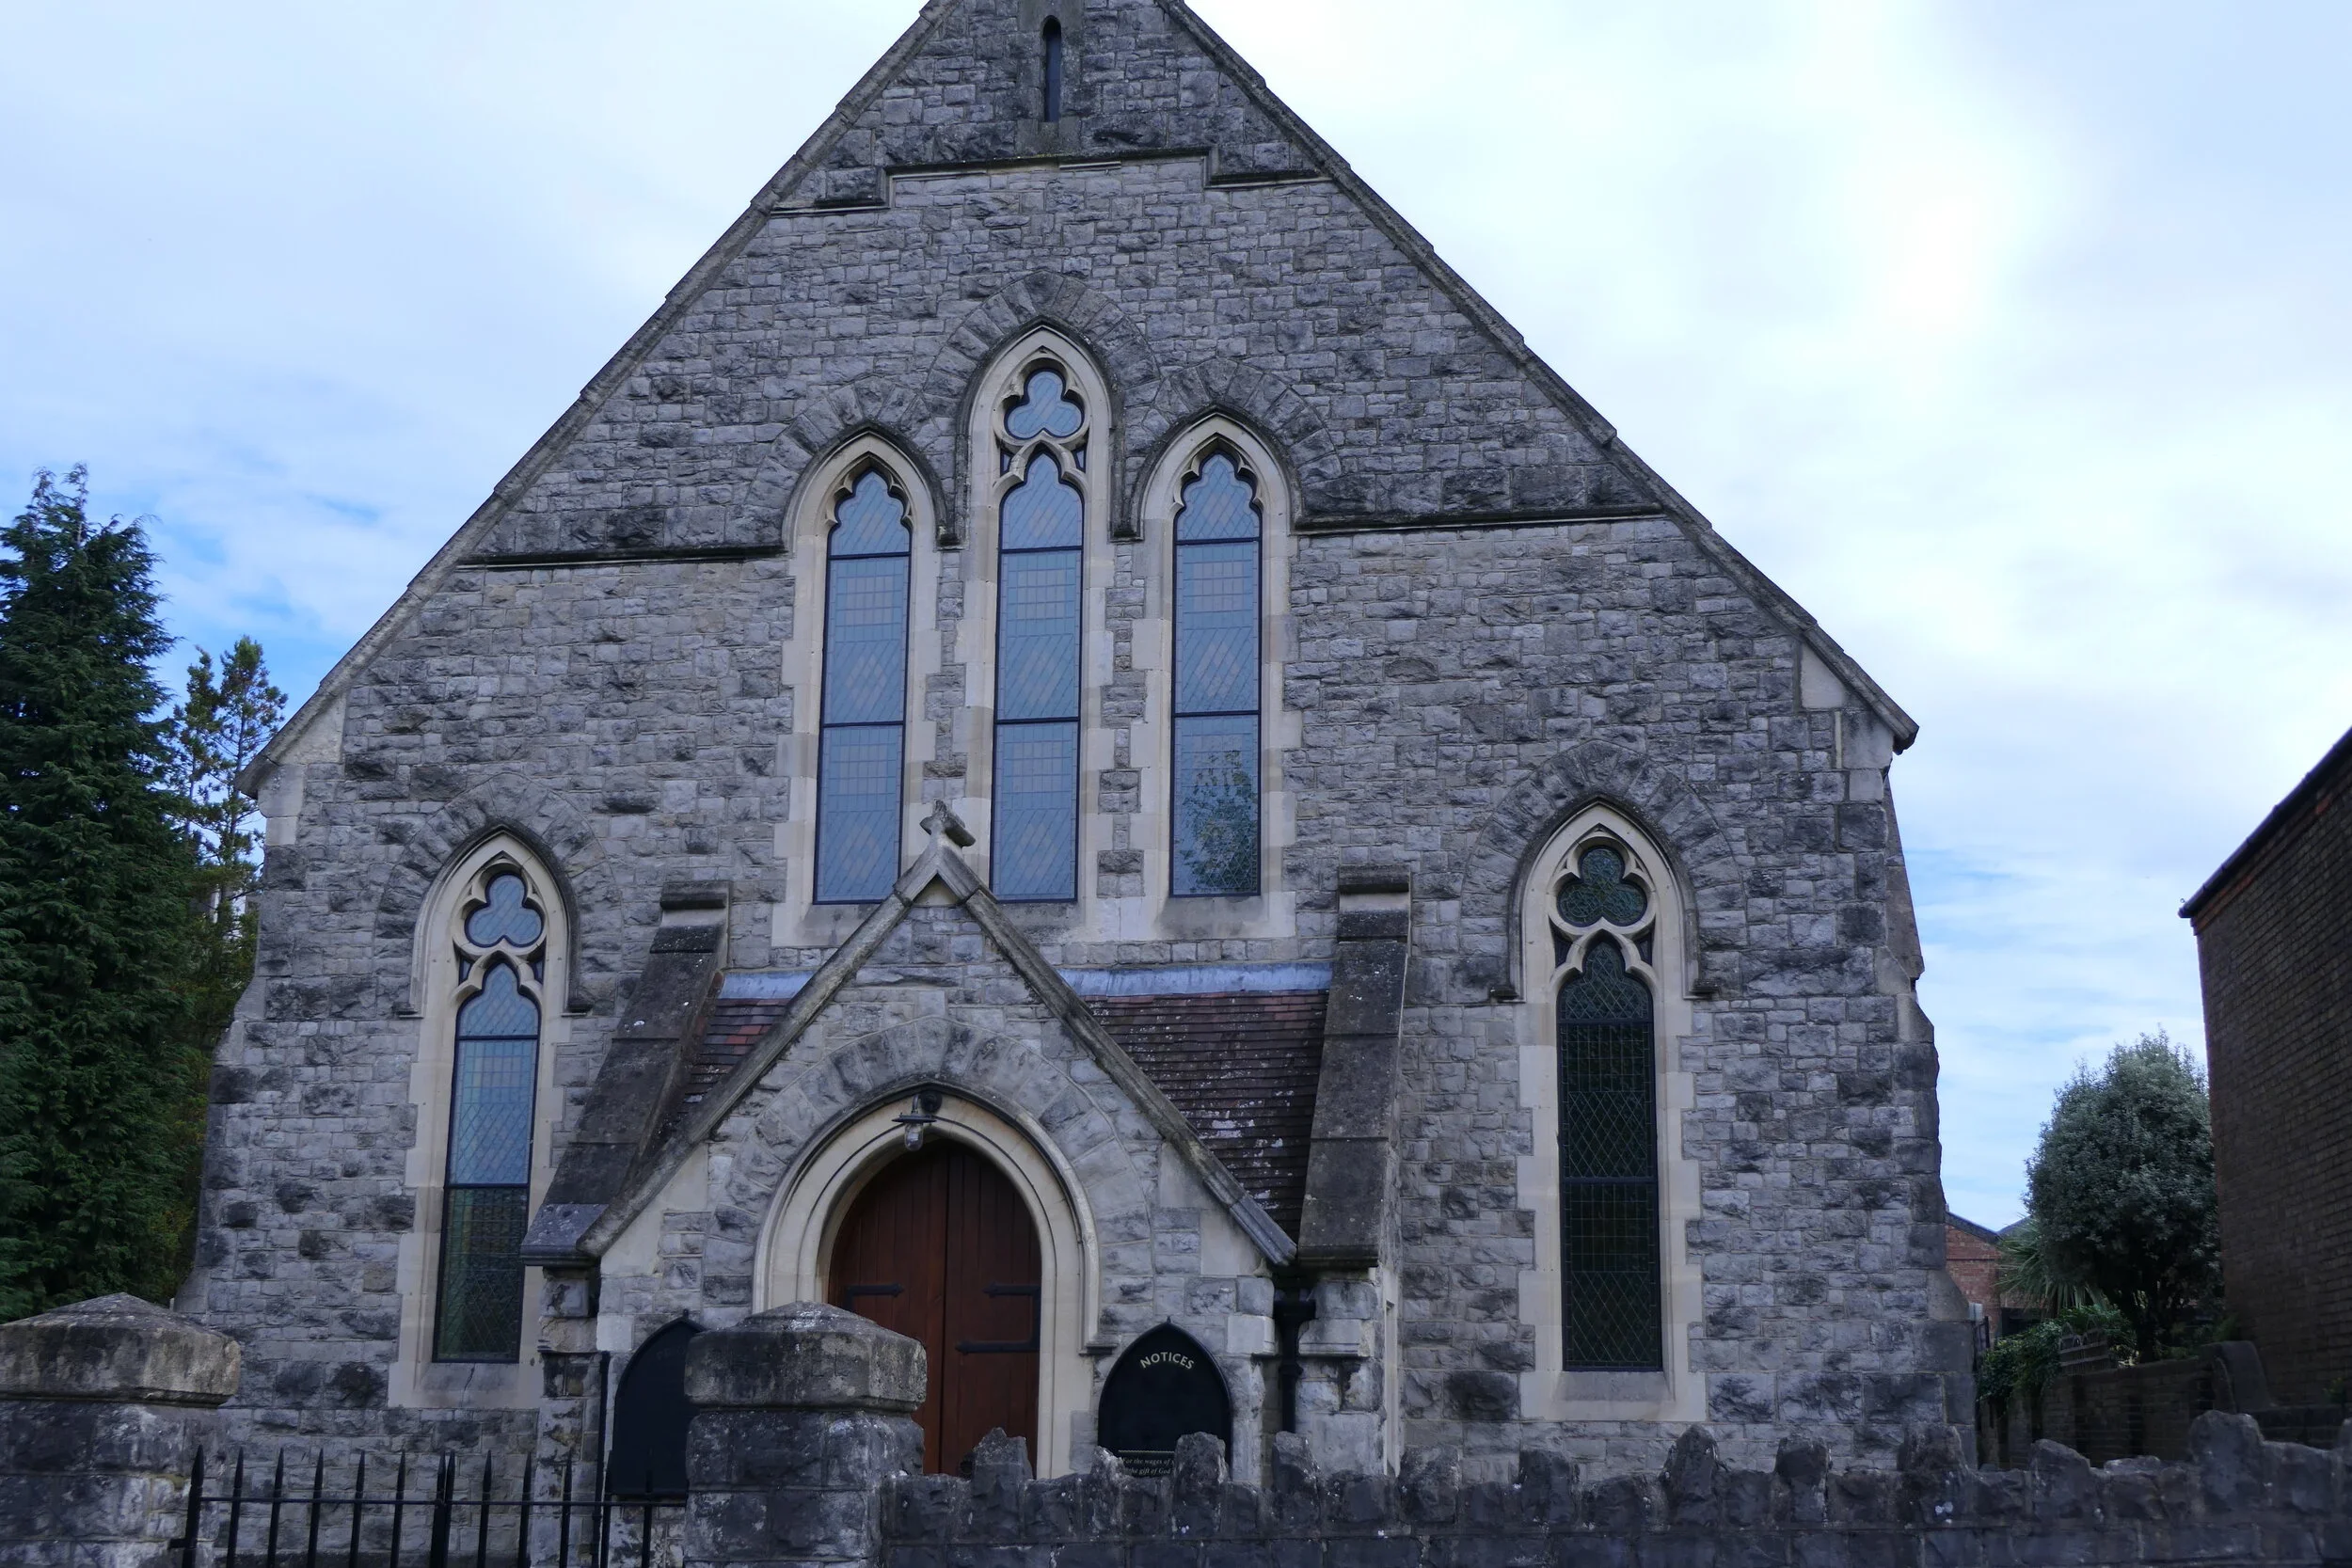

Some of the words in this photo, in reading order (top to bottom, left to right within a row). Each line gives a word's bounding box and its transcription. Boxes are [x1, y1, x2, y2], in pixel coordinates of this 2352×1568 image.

[1139, 1352, 1195, 1370] NOTICES
[1163, 1458, 1170, 1466] of
[1138, 1466, 1150, 1475] gift
